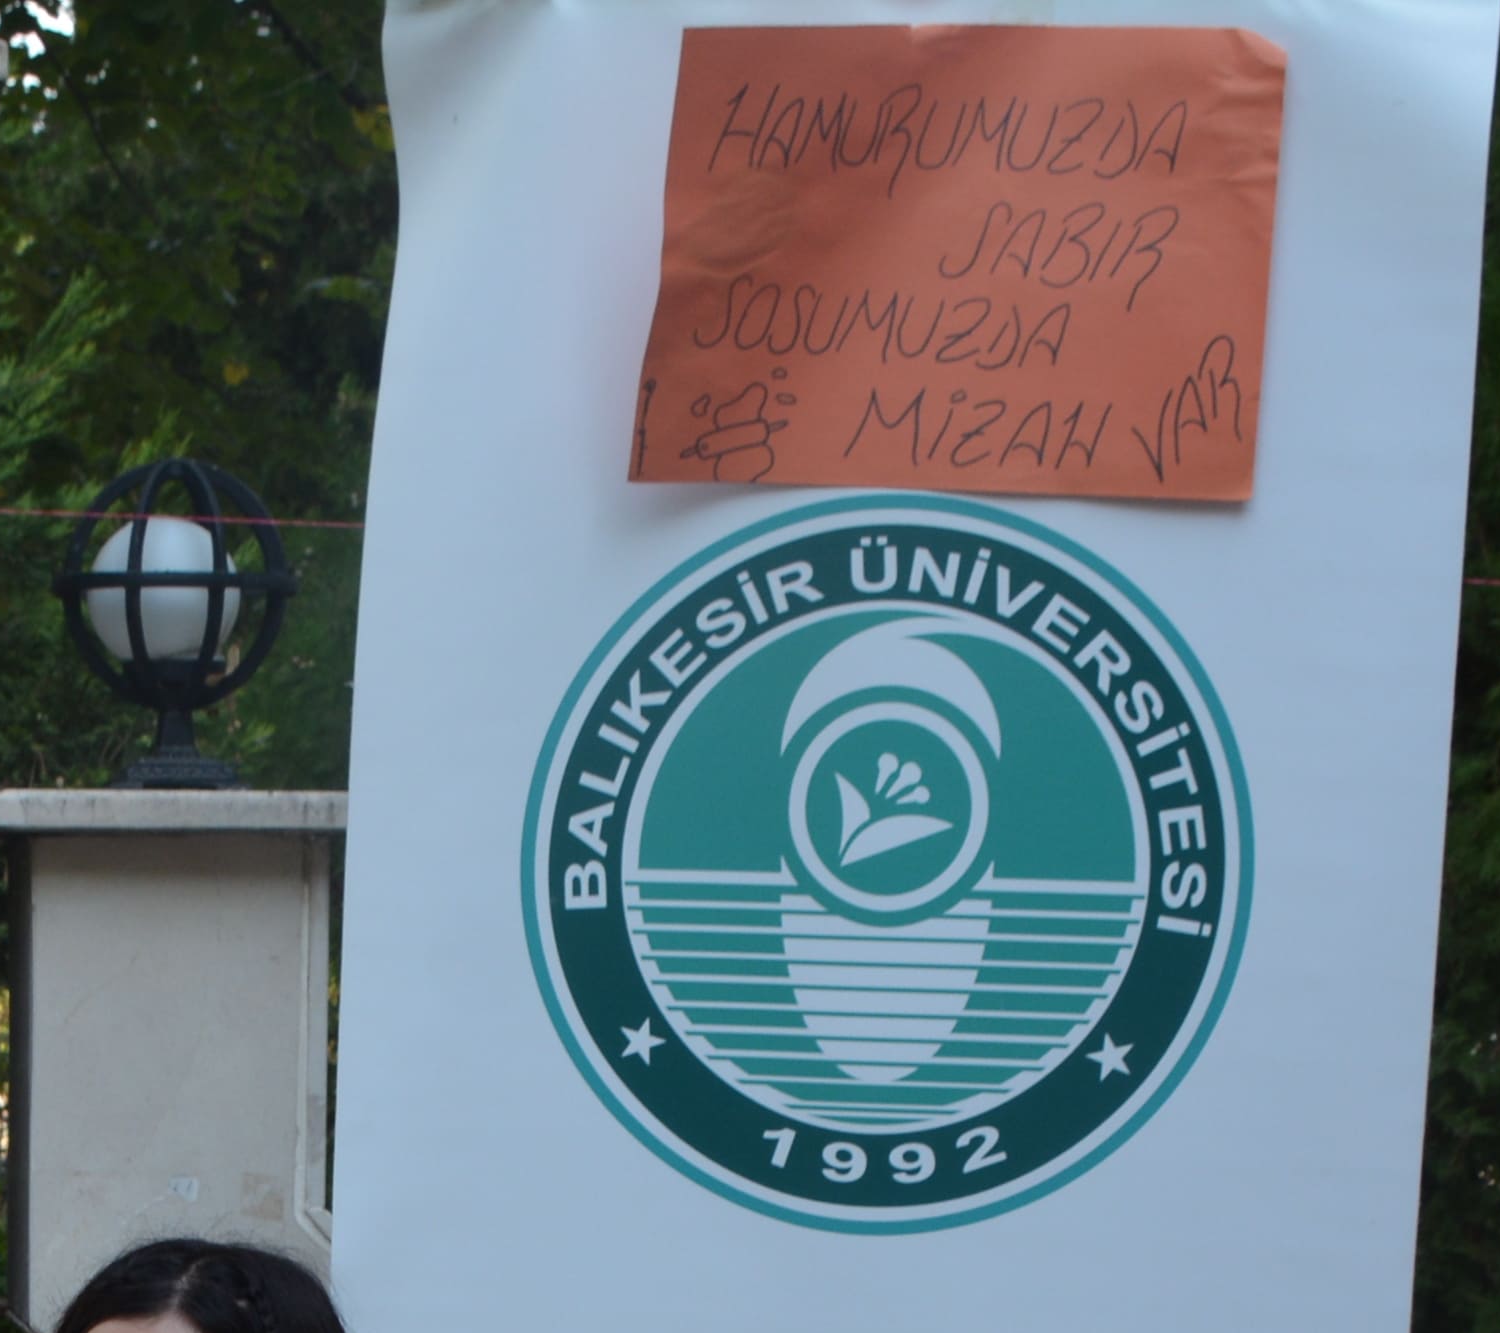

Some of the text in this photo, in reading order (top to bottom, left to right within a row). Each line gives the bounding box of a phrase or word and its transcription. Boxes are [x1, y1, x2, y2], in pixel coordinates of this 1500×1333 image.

[707, 82, 1188, 199] HAMURUMUZDA
[938, 201, 1180, 312] SABIR
[693, 273, 1072, 370] SOSUMUZDA
[1131, 334, 1243, 484] VAR
[563, 535, 1213, 940] BALIKESİR ÜNİVERSİTESİ
[762, 1126, 1008, 1185] 1992
